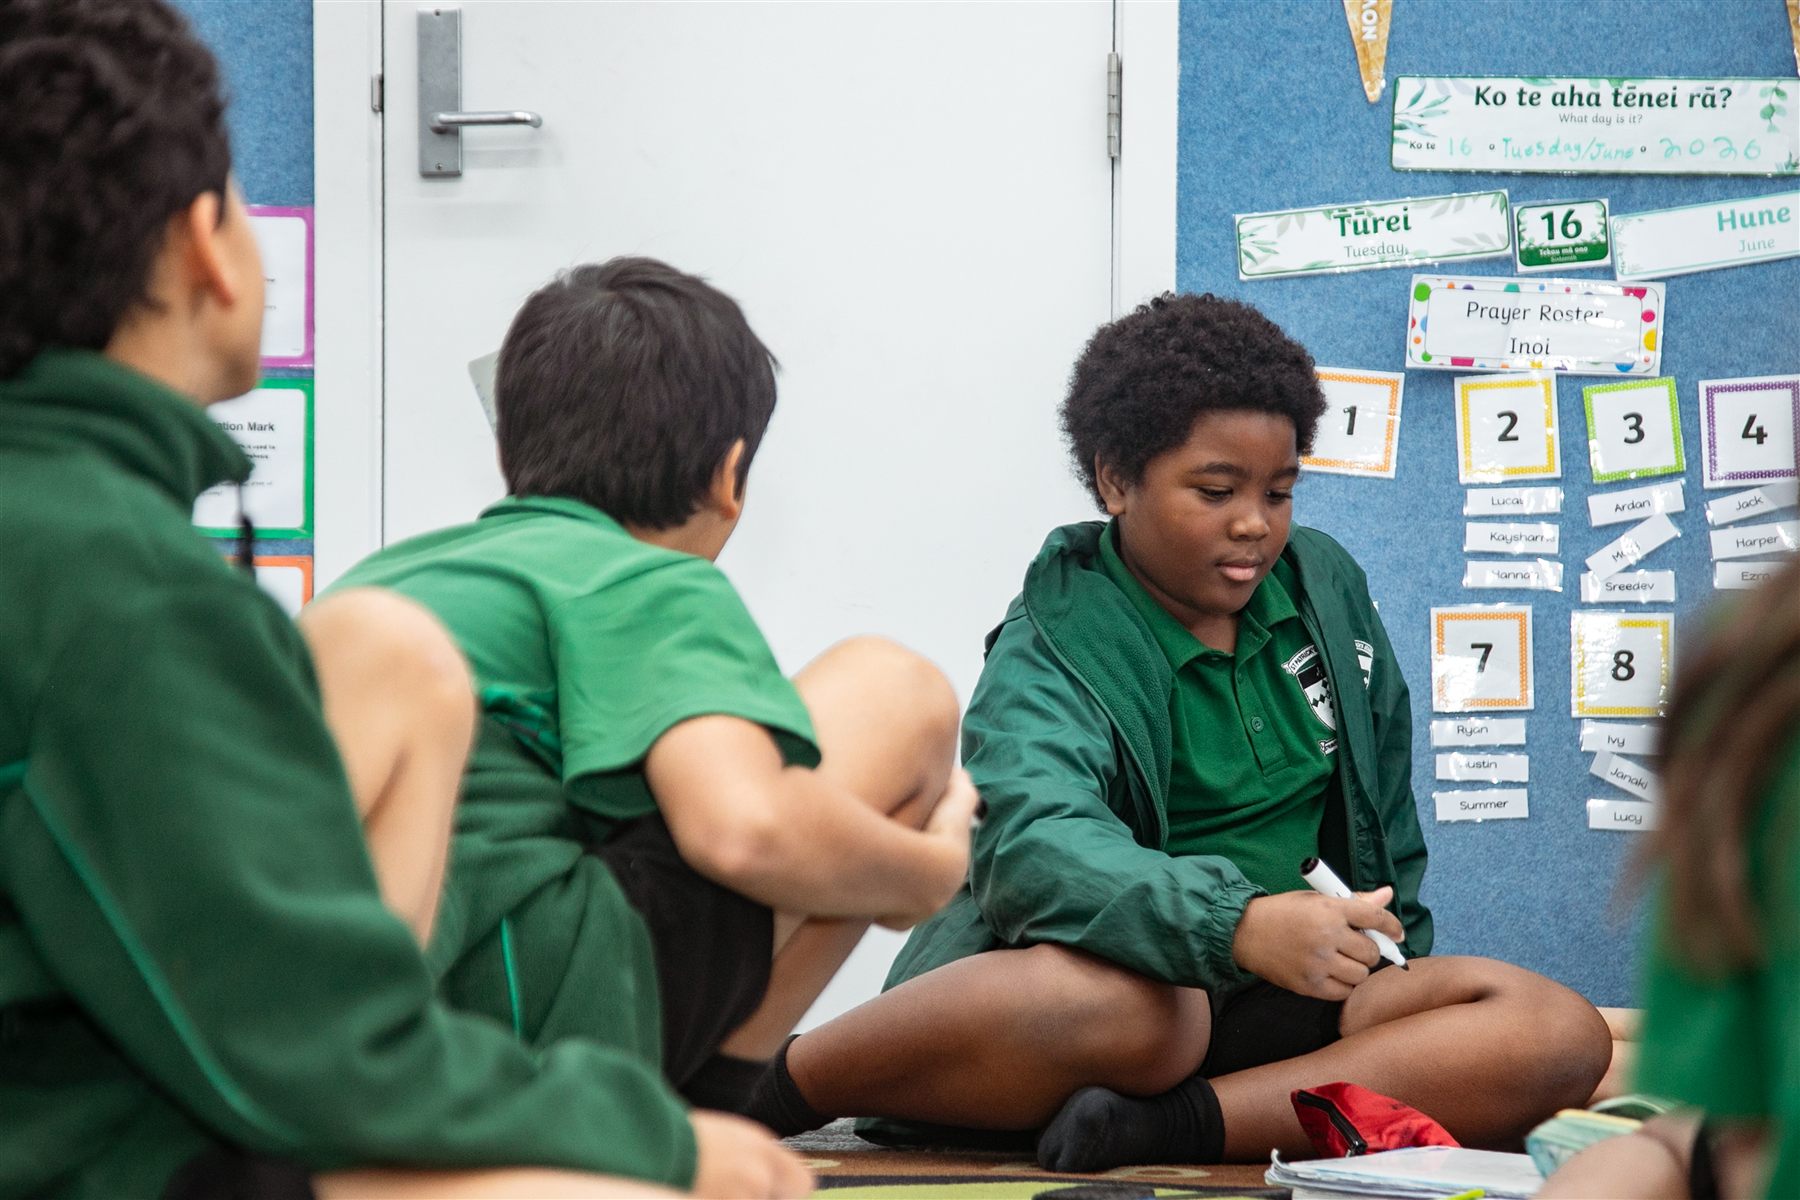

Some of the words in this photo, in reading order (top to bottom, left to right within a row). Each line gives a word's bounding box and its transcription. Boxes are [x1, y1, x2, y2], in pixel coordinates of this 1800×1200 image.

[1475, 86, 1506, 107] Ko
[1517, 87, 1541, 107] te
[1551, 85, 1602, 107] aha
[1612, 85, 1678, 108] tēnei
[1688, 86, 1732, 108] rā?
[1559, 113, 1588, 124] What
[1592, 113, 1612, 126] day
[1616, 113, 1626, 124] is
[1628, 113, 1643, 124] it?
[1409, 141, 1423, 149] Ko
[1426, 141, 1436, 150] te
[1449, 137, 1472, 156] 16
[1333, 206, 1412, 237] Tūrei
[1541, 208, 1582, 240] 16
[1717, 206, 1791, 232] Hune
[1739, 239, 1775, 253] June
[1467, 301, 1531, 325] Prayer
[1540, 304, 1604, 321] Roster
[1510, 337, 1550, 355] Inoi
[247, 421, 275, 431] Mark
[1343, 405, 1357, 435] 1
[1497, 410, 1519, 441] 2
[1623, 412, 1645, 444] 3
[1742, 414, 1768, 445] 4
[1614, 499, 1651, 513] Ardan
[1735, 496, 1763, 511] Jack
[1736, 535, 1779, 548] Harper
[1606, 582, 1655, 592] Sreedev
[1471, 643, 1493, 673] 7
[1611, 650, 1635, 681] 8
[1457, 725, 1489, 737] Ryan
[1607, 735, 1625, 747] Ivy
[1460, 760, 1498, 768] ustin
[1610, 768, 1648, 790] Janaki
[1460, 801, 1509, 810] Summer
[1613, 812, 1643, 825] Lucy
